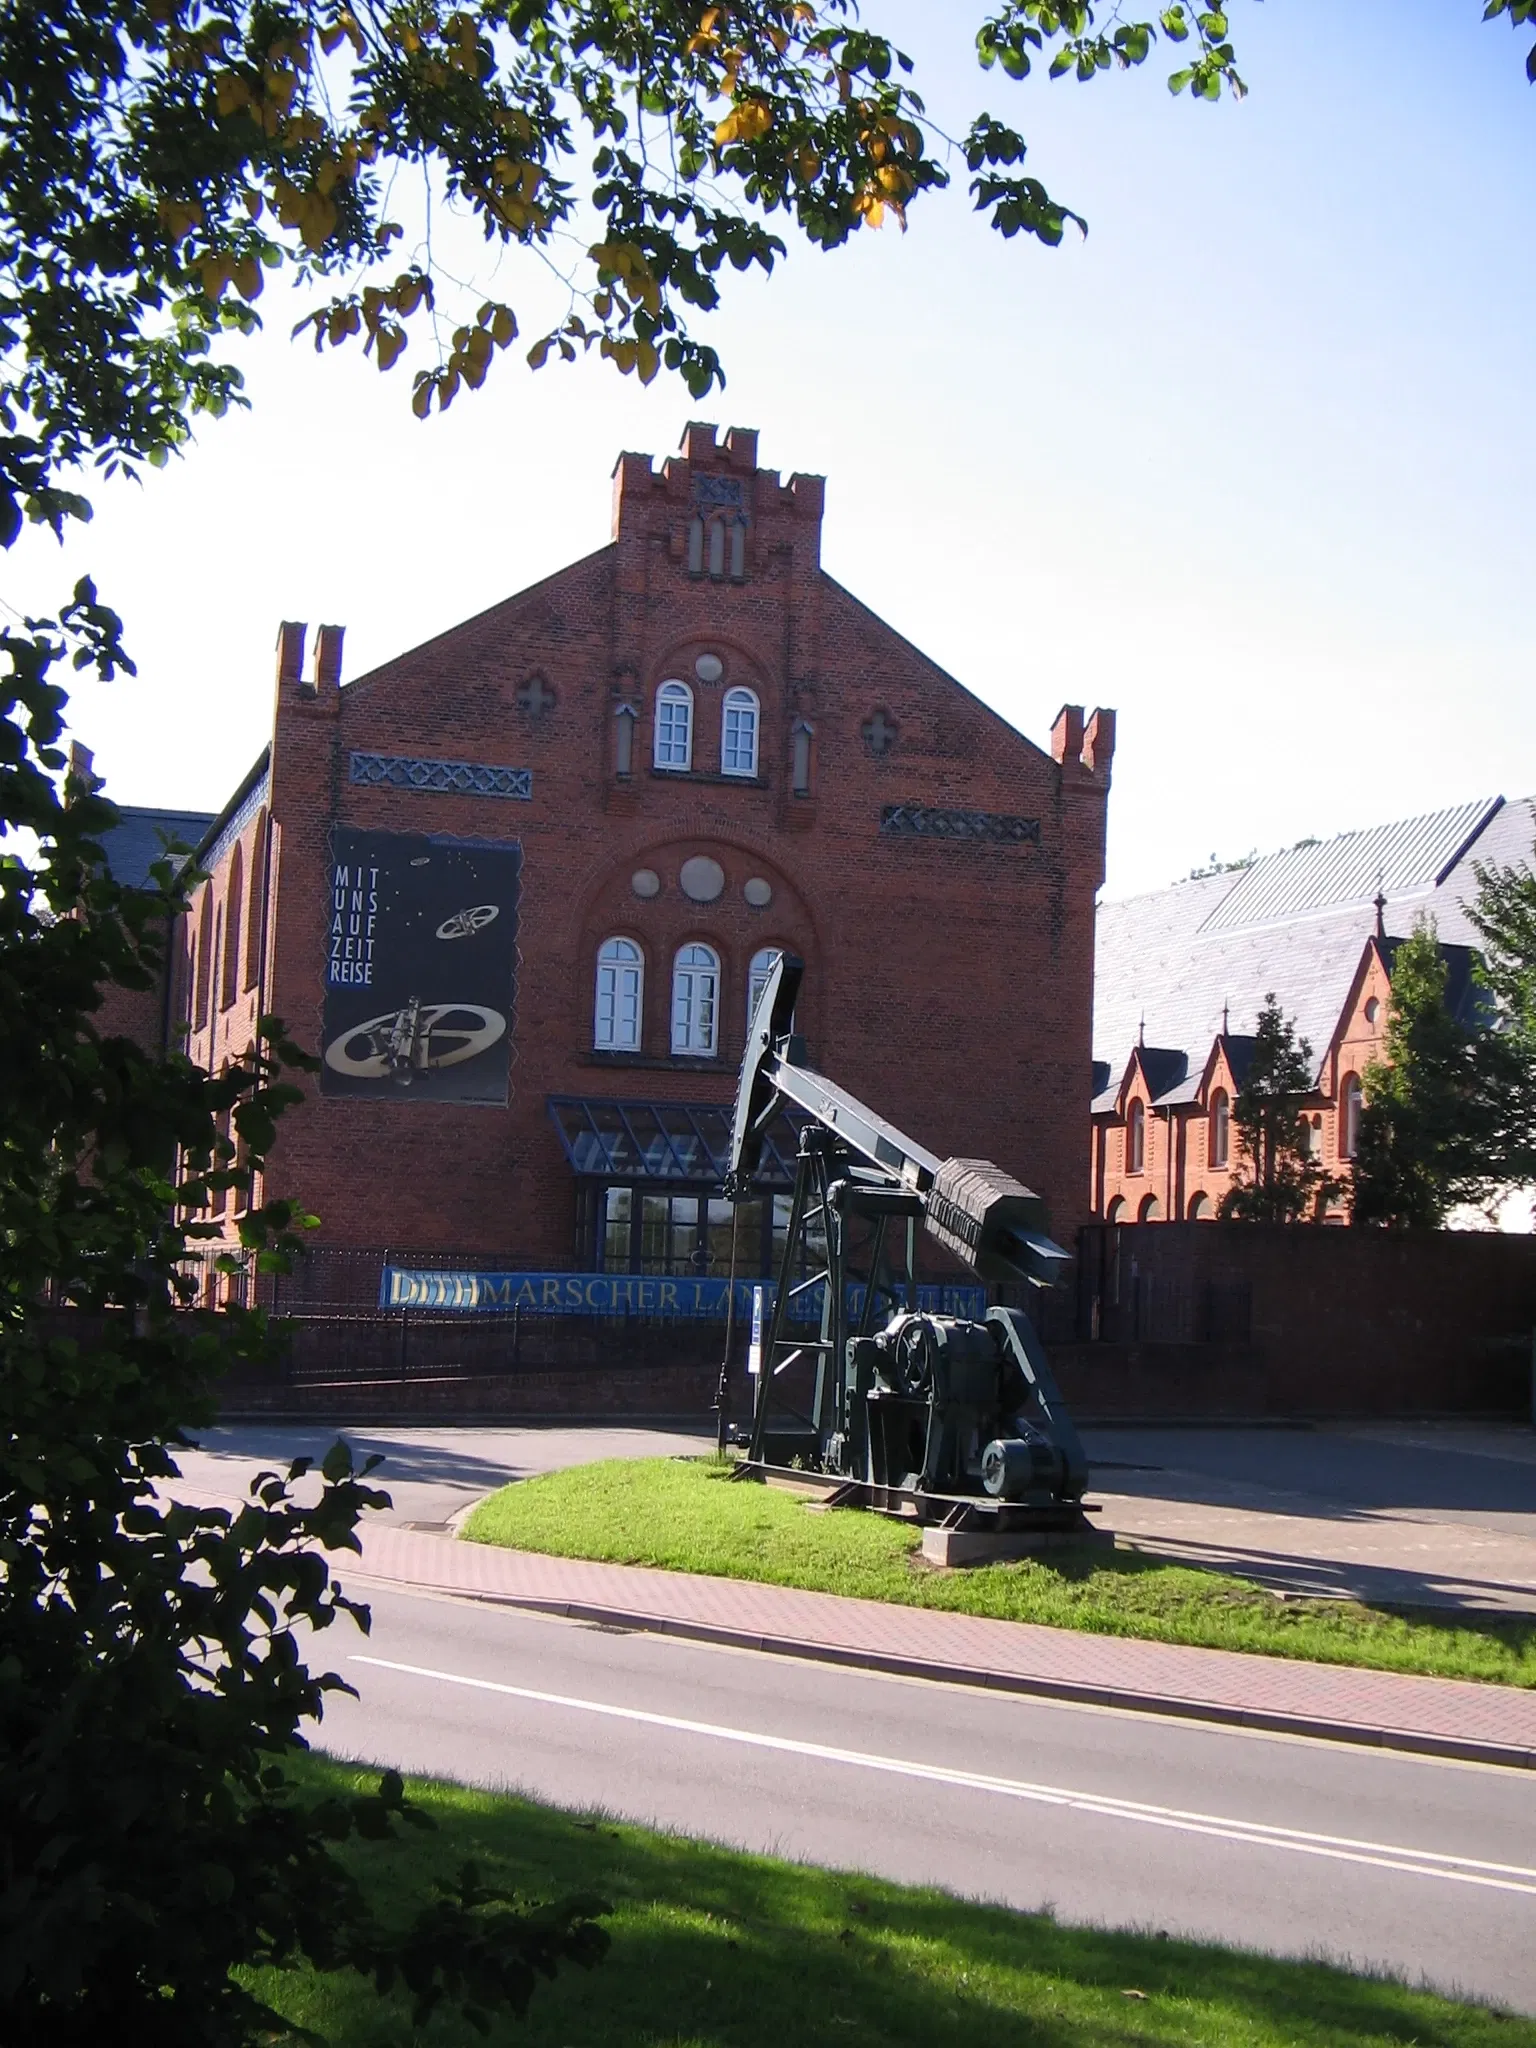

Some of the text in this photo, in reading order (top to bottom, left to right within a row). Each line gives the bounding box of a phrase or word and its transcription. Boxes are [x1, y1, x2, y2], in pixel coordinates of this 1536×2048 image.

[335, 865, 379, 888] MIT
[334, 890, 378, 913] UNS
[332, 914, 376, 937] AUF
[331, 937, 375, 960] ZEIT
[330, 961, 373, 985] REISE
[389, 1271, 681, 1310] DITHMARSCHER
